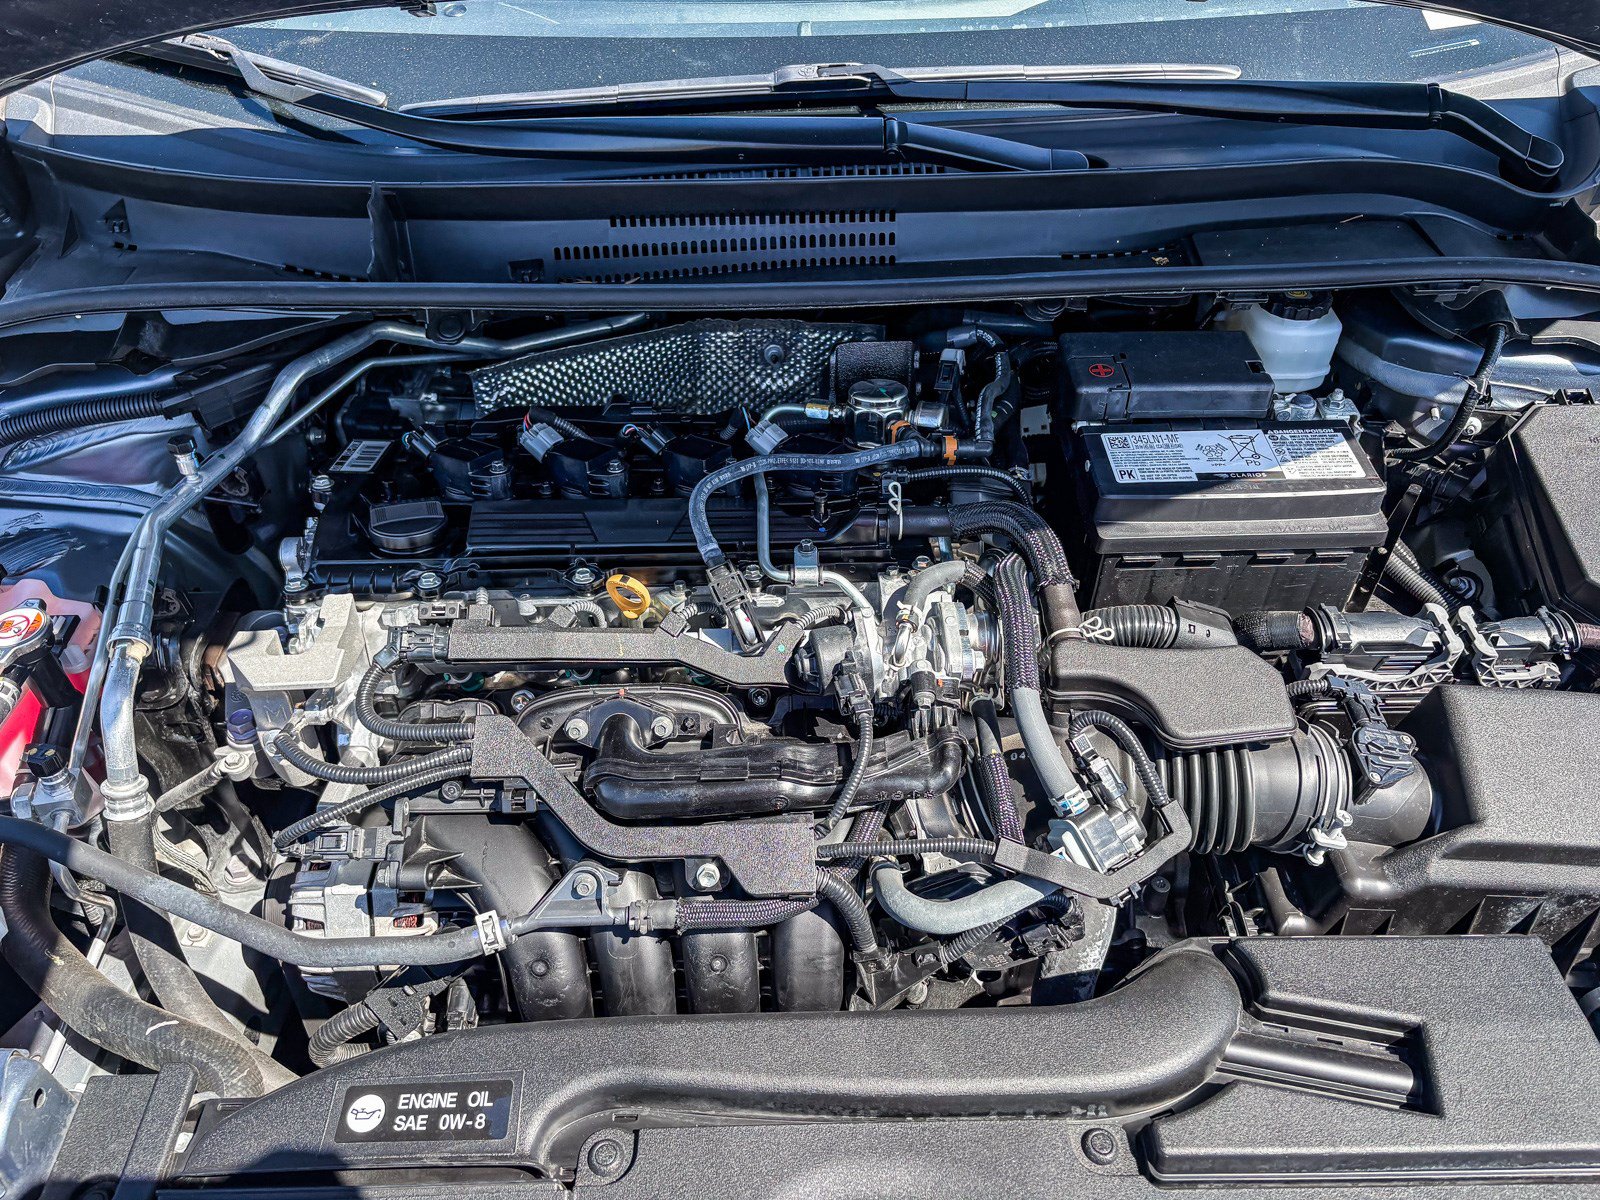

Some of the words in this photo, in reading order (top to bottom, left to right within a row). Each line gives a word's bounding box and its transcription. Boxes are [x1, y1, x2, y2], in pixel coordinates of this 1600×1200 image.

[1131, 433, 1180, 444] 345LN1-MF
[1245, 459, 1261, 467] Pb
[1119, 469, 1136, 480] PK
[397, 1092, 459, 1110] ENGINE
[467, 1090, 494, 1107] OIL
[393, 1114, 429, 1132] SAE
[439, 1113, 487, 1131] 0W-8
